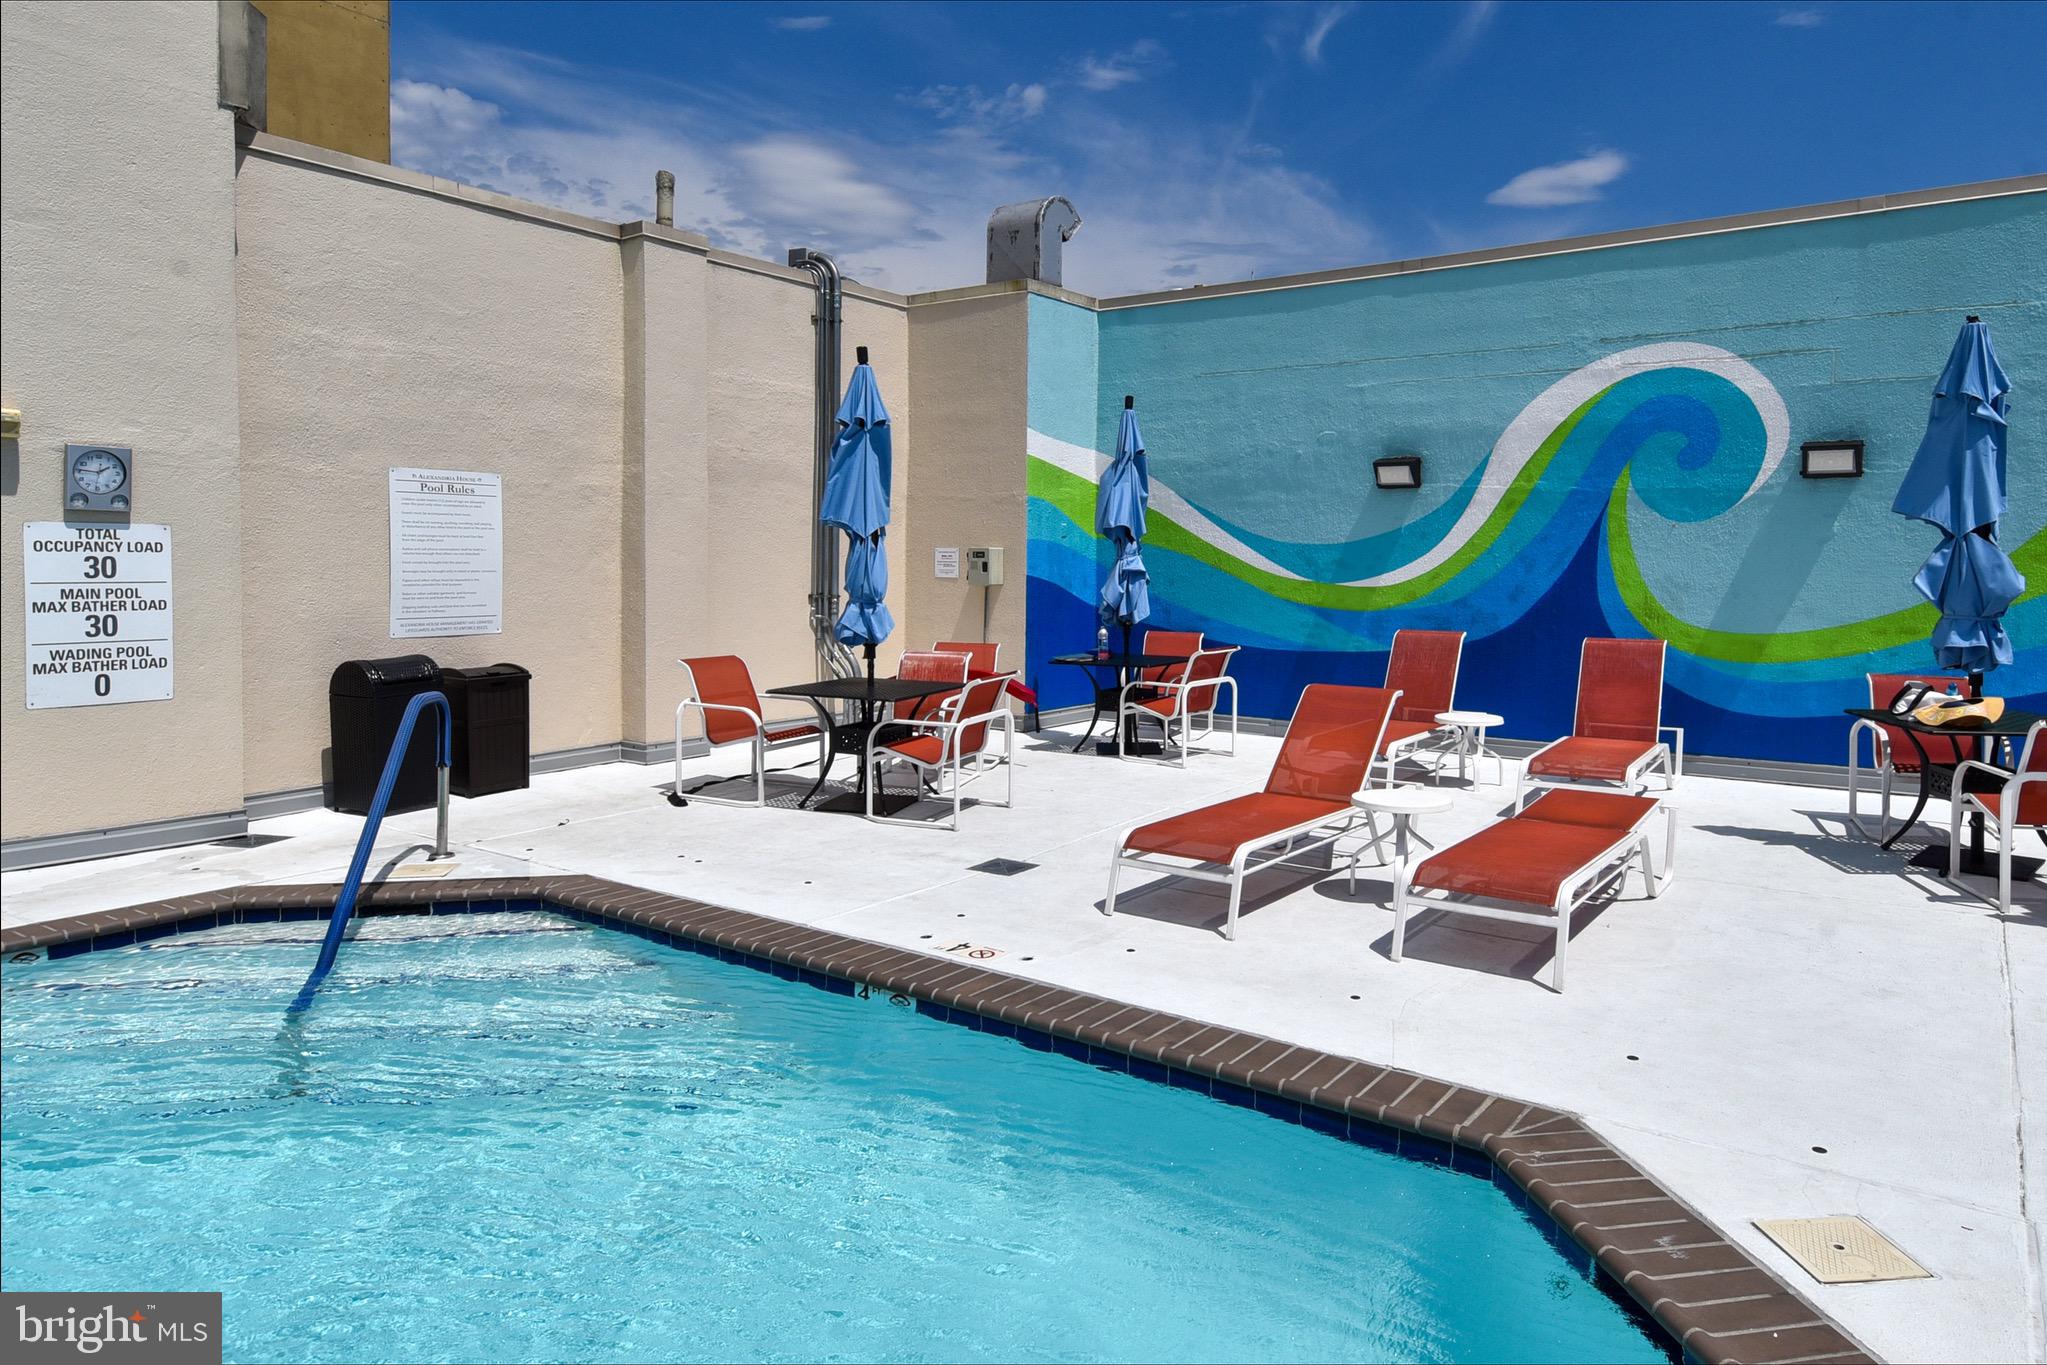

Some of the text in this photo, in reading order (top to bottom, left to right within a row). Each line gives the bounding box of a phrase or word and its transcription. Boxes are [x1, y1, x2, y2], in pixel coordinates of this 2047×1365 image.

[418, 473, 456, 482] ALEXANDRIA
[420, 482, 476, 494] Pool Rules
[75, 528, 121, 540] TOTAL
[33, 540, 164, 553] OCCUPANCY LOAD
[83, 555, 118, 579] 30
[60, 587, 142, 600] MAIN POOL
[31, 599, 167, 613] MAX BATHER LOAD
[84, 614, 118, 638] 30
[50, 646, 153, 661] WADING POOL
[32, 657, 168, 675] MAX BATHER LOAD
[94, 673, 111, 696] 0
[857, 983, 871, 1001] 4
